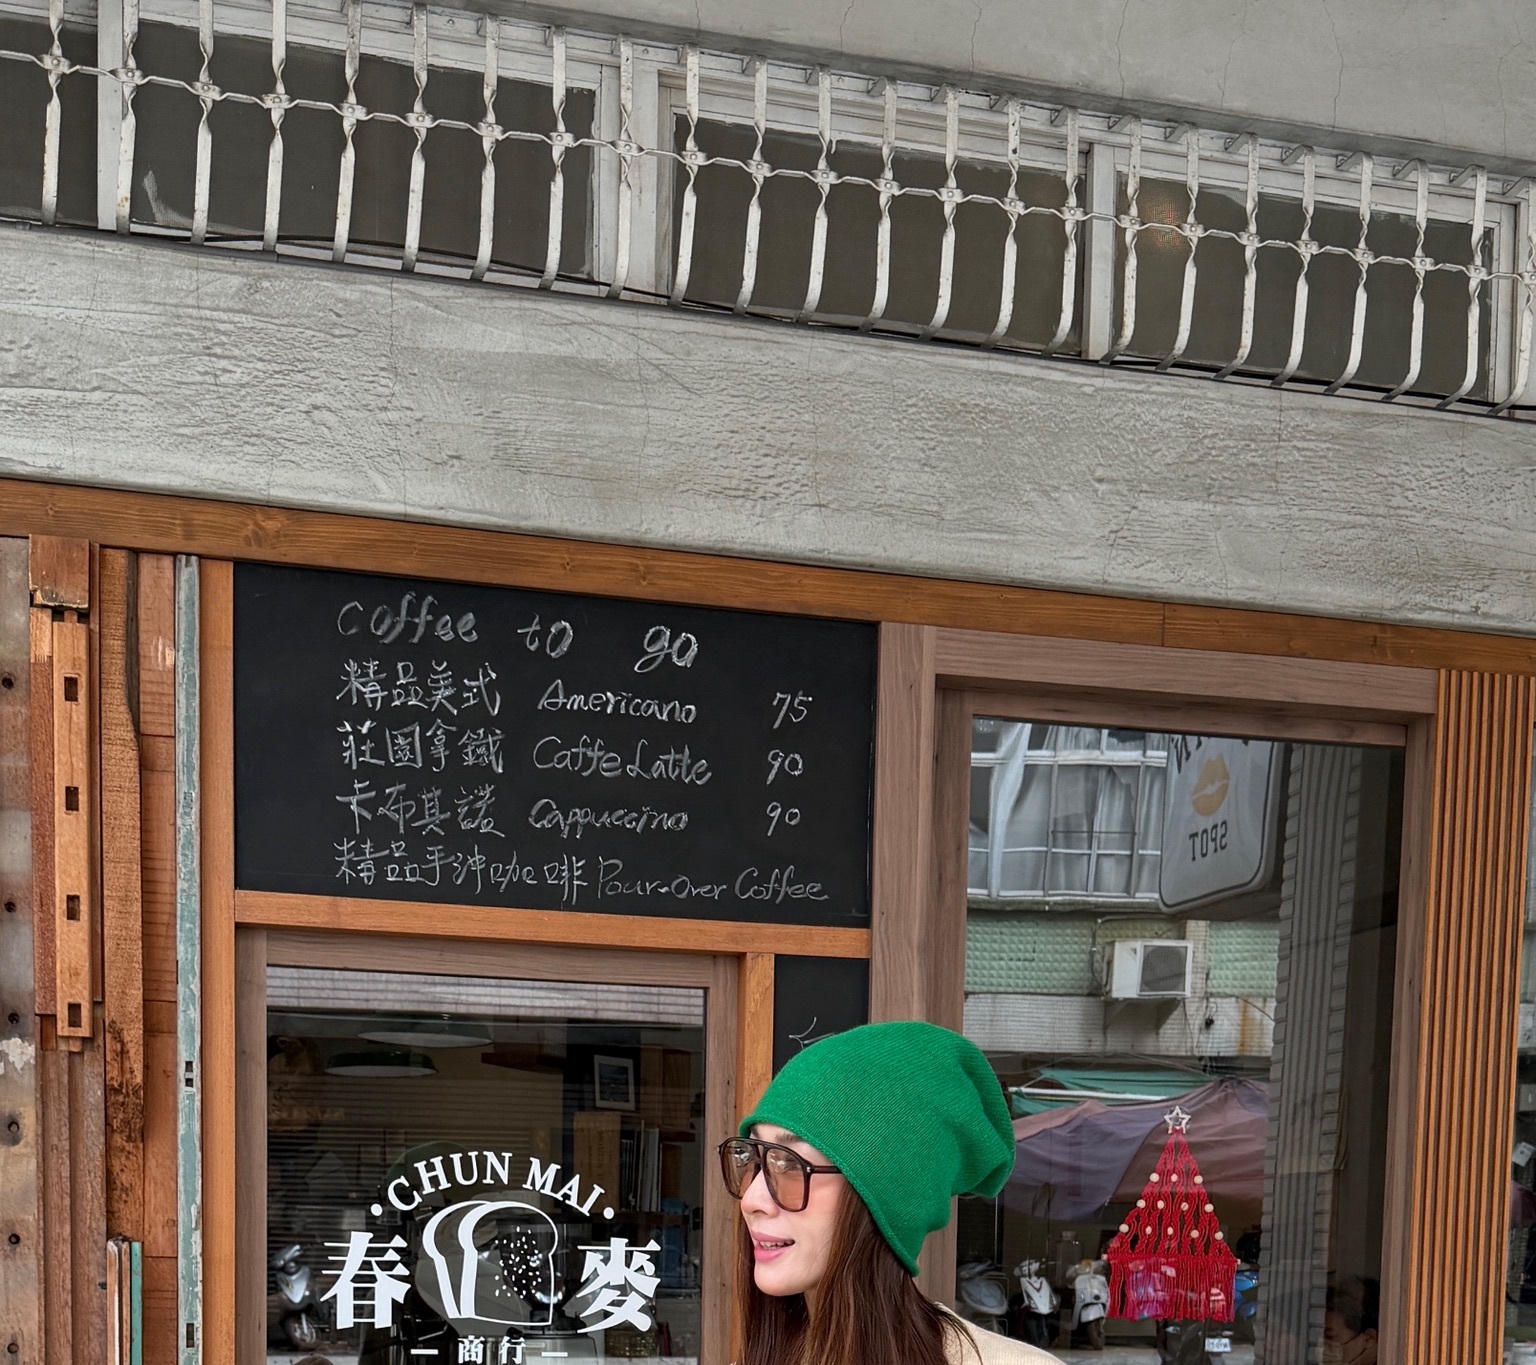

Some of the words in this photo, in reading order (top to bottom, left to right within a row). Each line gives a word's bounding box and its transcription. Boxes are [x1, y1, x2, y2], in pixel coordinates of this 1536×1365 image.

[517, 612, 574, 658] to
[336, 658, 501, 717] 精品美式
[537, 679, 698, 724] Americano
[772, 690, 813, 729] 75
[766, 749, 804, 785] 90
[528, 799, 689, 839] Cappuccino
[766, 802, 801, 836] 90
[734, 865, 829, 904] Coffee
[387, 1151, 513, 1212] CHUN
[522, 1157, 606, 1218] MAI
[320, 1231, 412, 1330] 春
[576, 1237, 662, 1335] 麥
[457, 1335, 528, 1365] 商行
